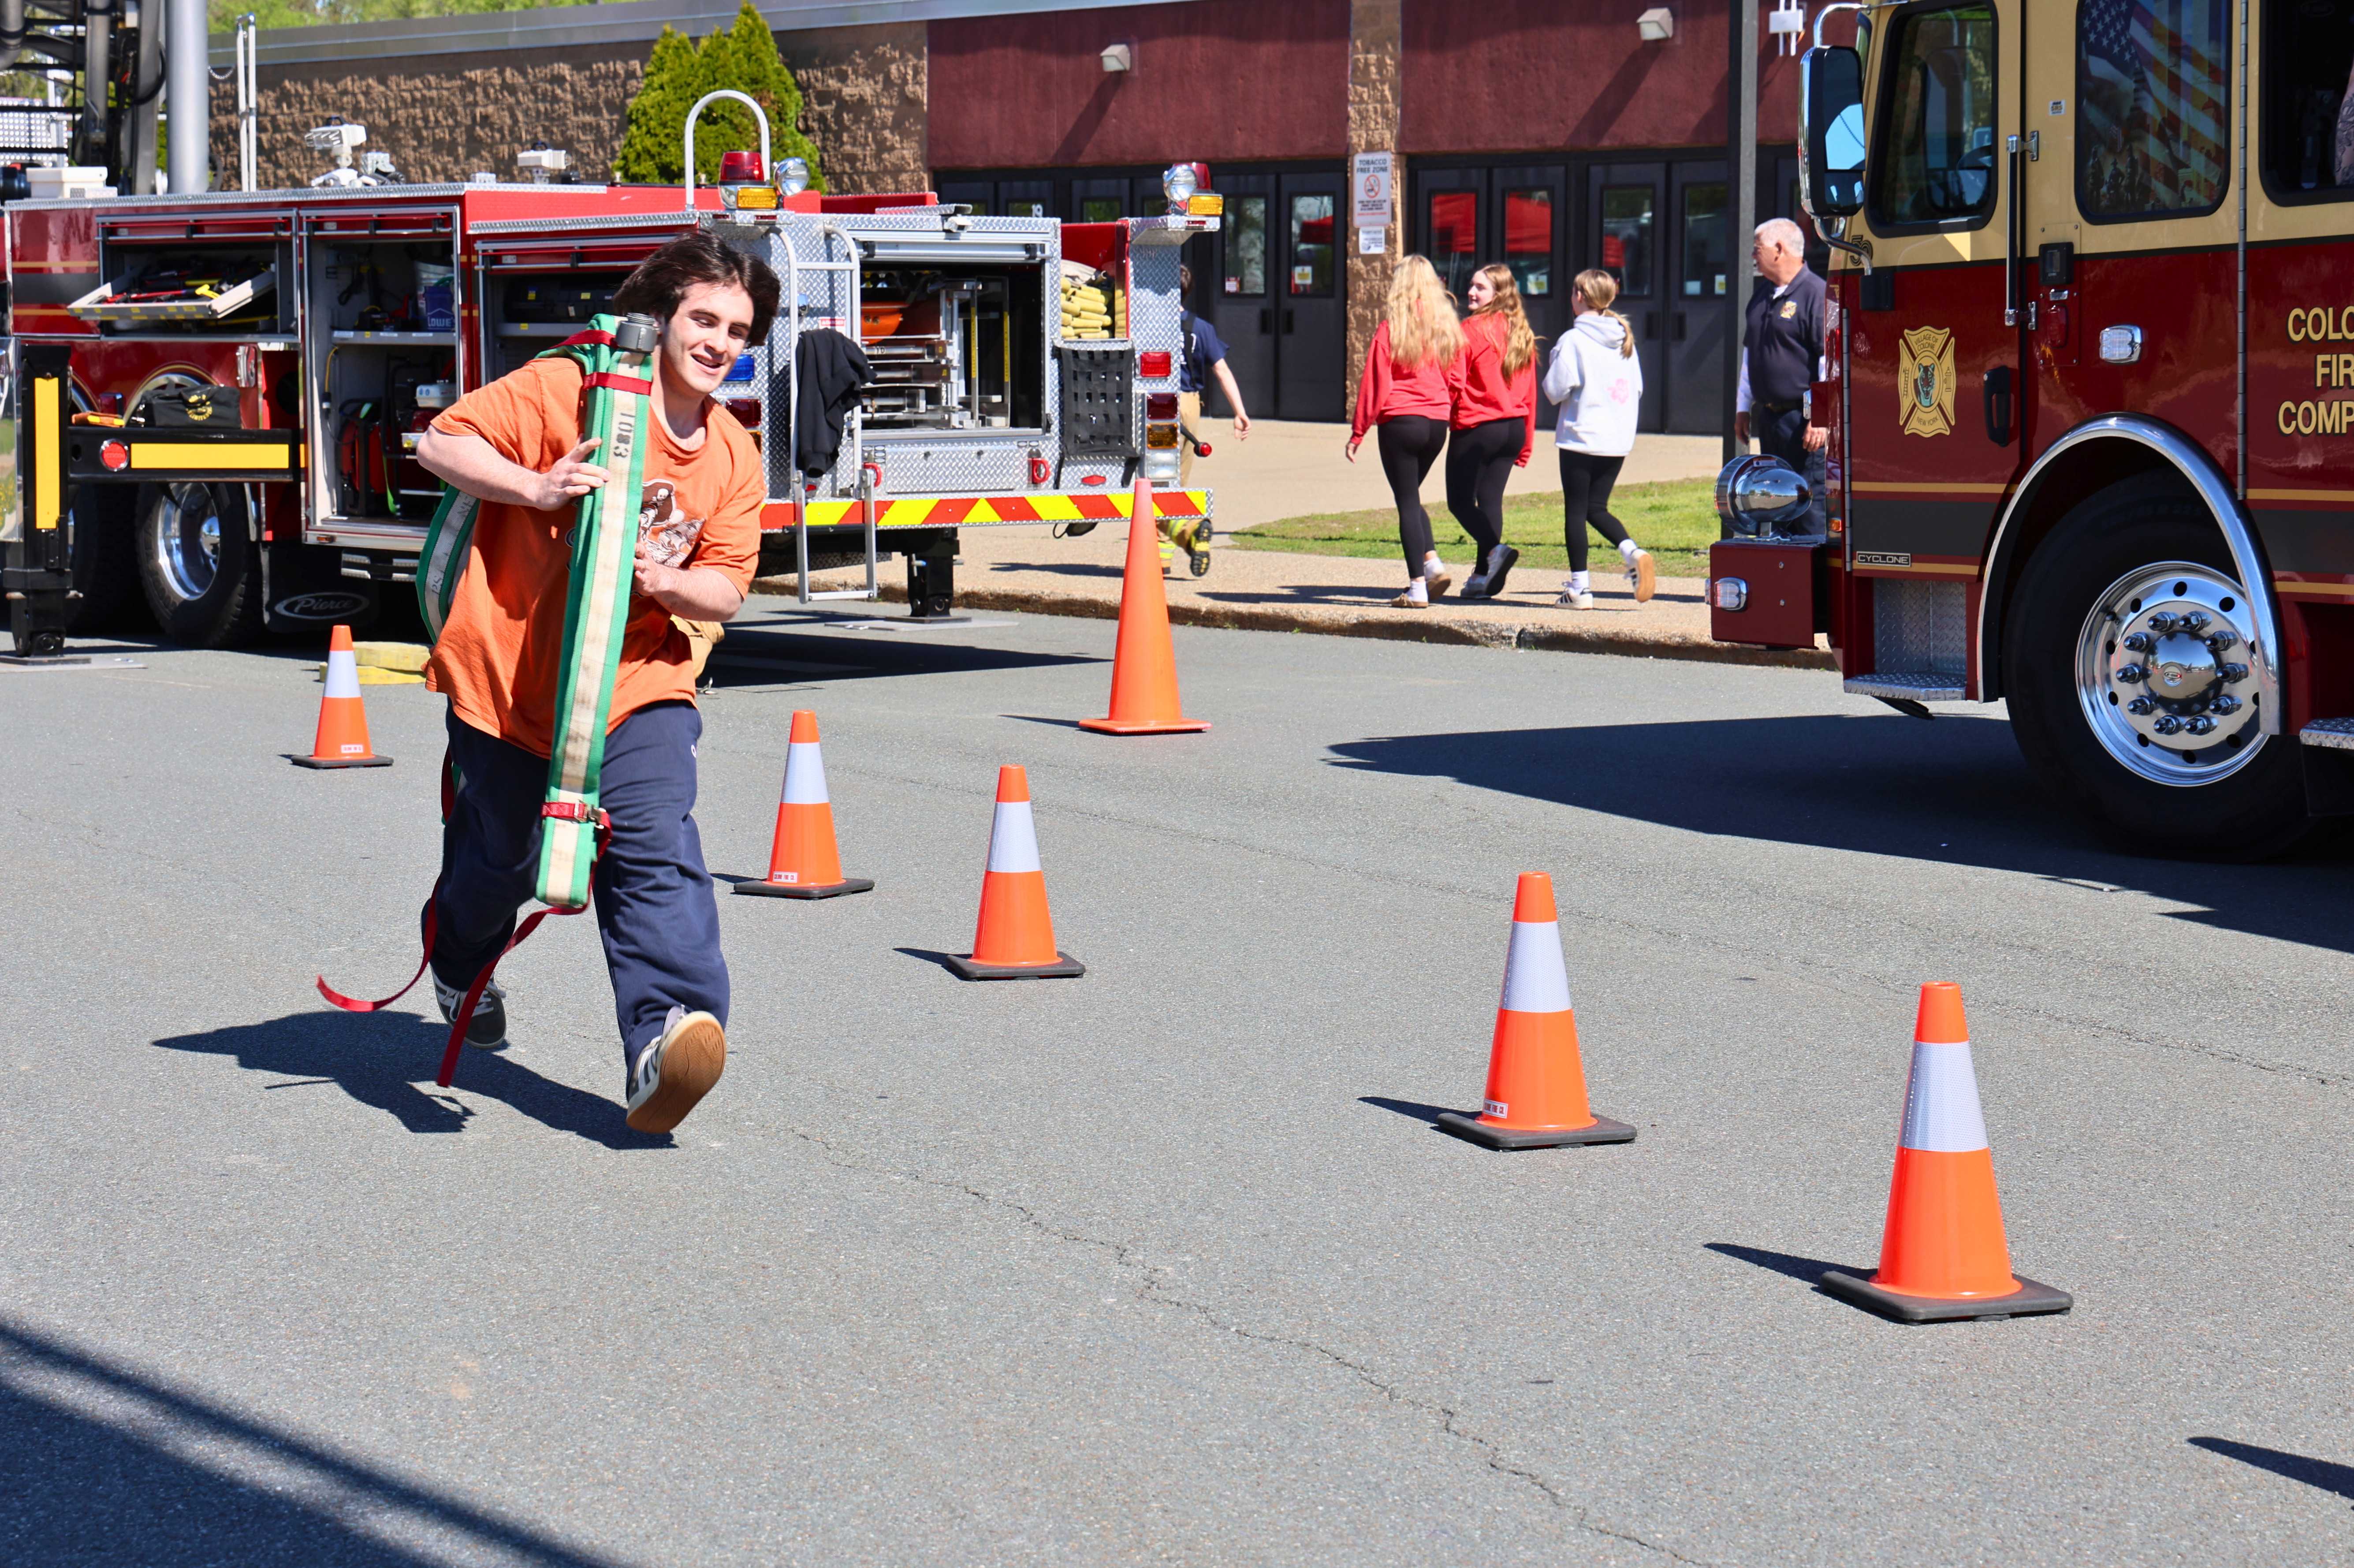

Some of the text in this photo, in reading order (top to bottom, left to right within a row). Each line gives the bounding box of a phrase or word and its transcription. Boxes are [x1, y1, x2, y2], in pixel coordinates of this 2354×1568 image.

[1915, 333, 1931, 346] VILLAGE
[1918, 342, 1935, 351] COLONIE
[2317, 354, 2354, 387] FIR
[1917, 415, 1939, 426] NEW YORK
[2278, 401, 2354, 434] COMP
[1858, 555, 1908, 564] CYCLONE
[294, 598, 353, 613] Pierce
